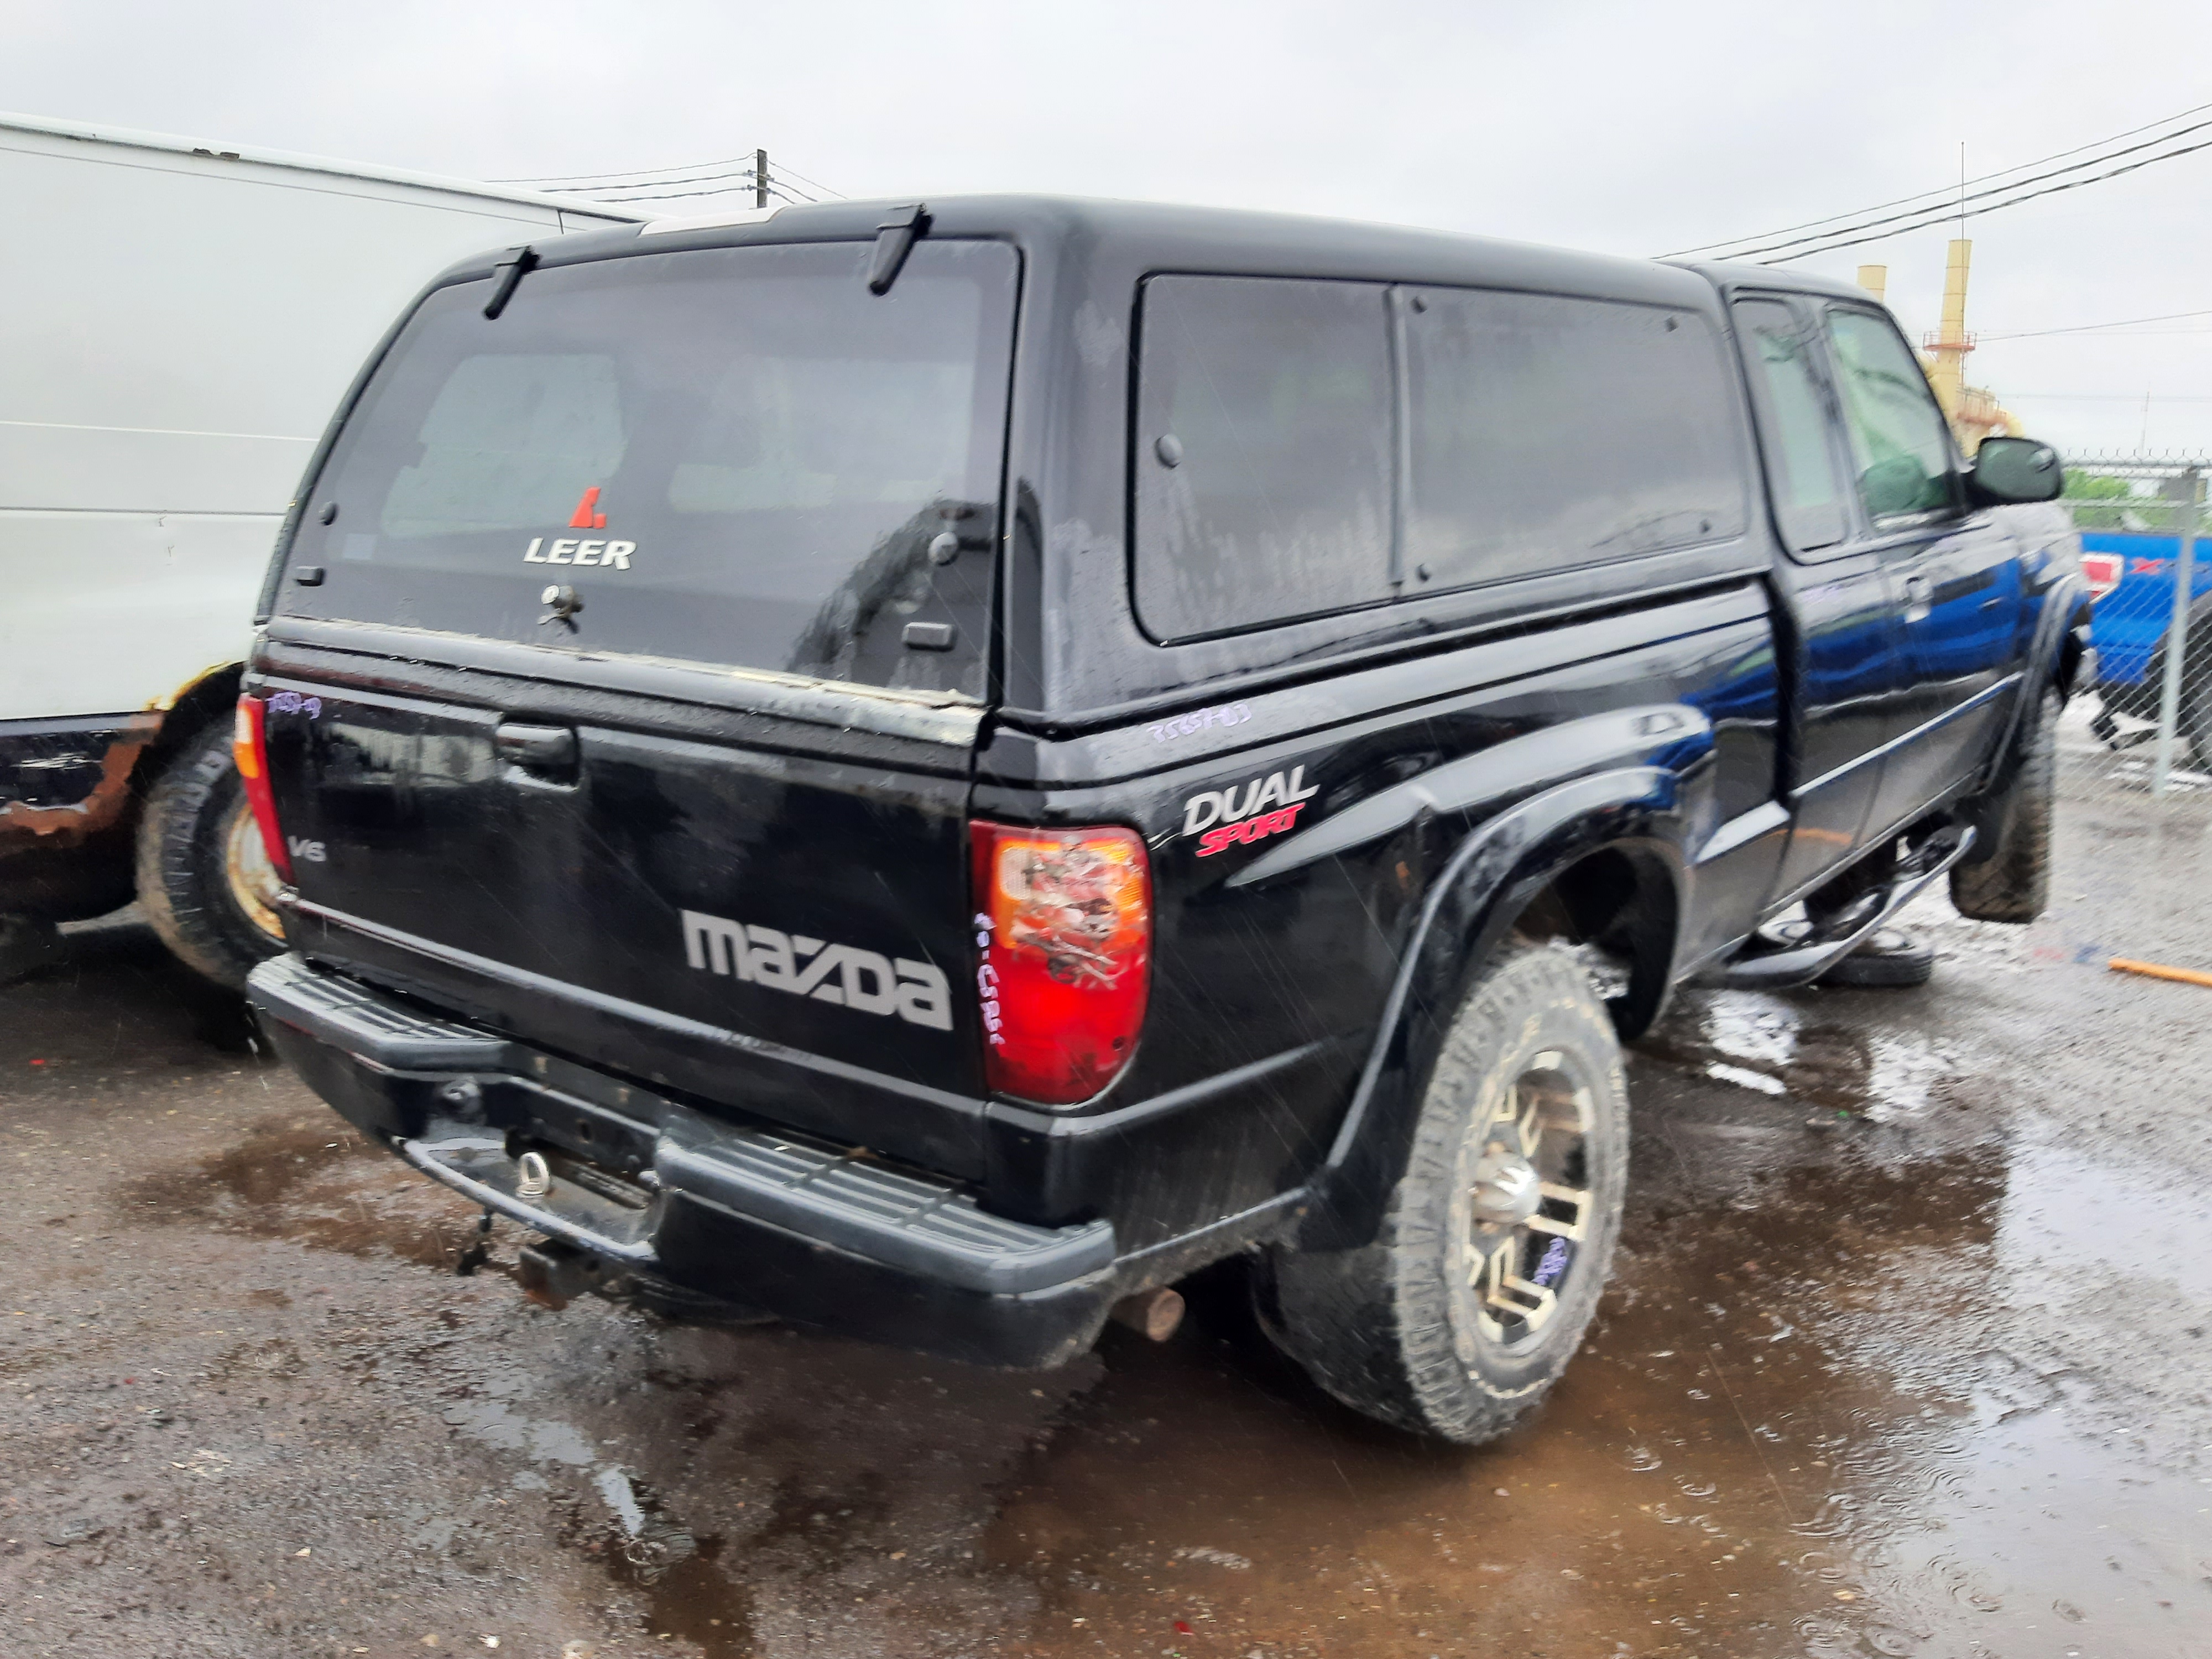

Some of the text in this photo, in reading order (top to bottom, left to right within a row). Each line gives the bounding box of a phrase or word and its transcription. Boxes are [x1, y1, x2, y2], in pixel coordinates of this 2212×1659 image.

[523, 536, 637, 570] LEER
[1182, 764, 1321, 837] DUAL
[287, 834, 327, 862] V6
[1195, 802, 1306, 858] SPORT
